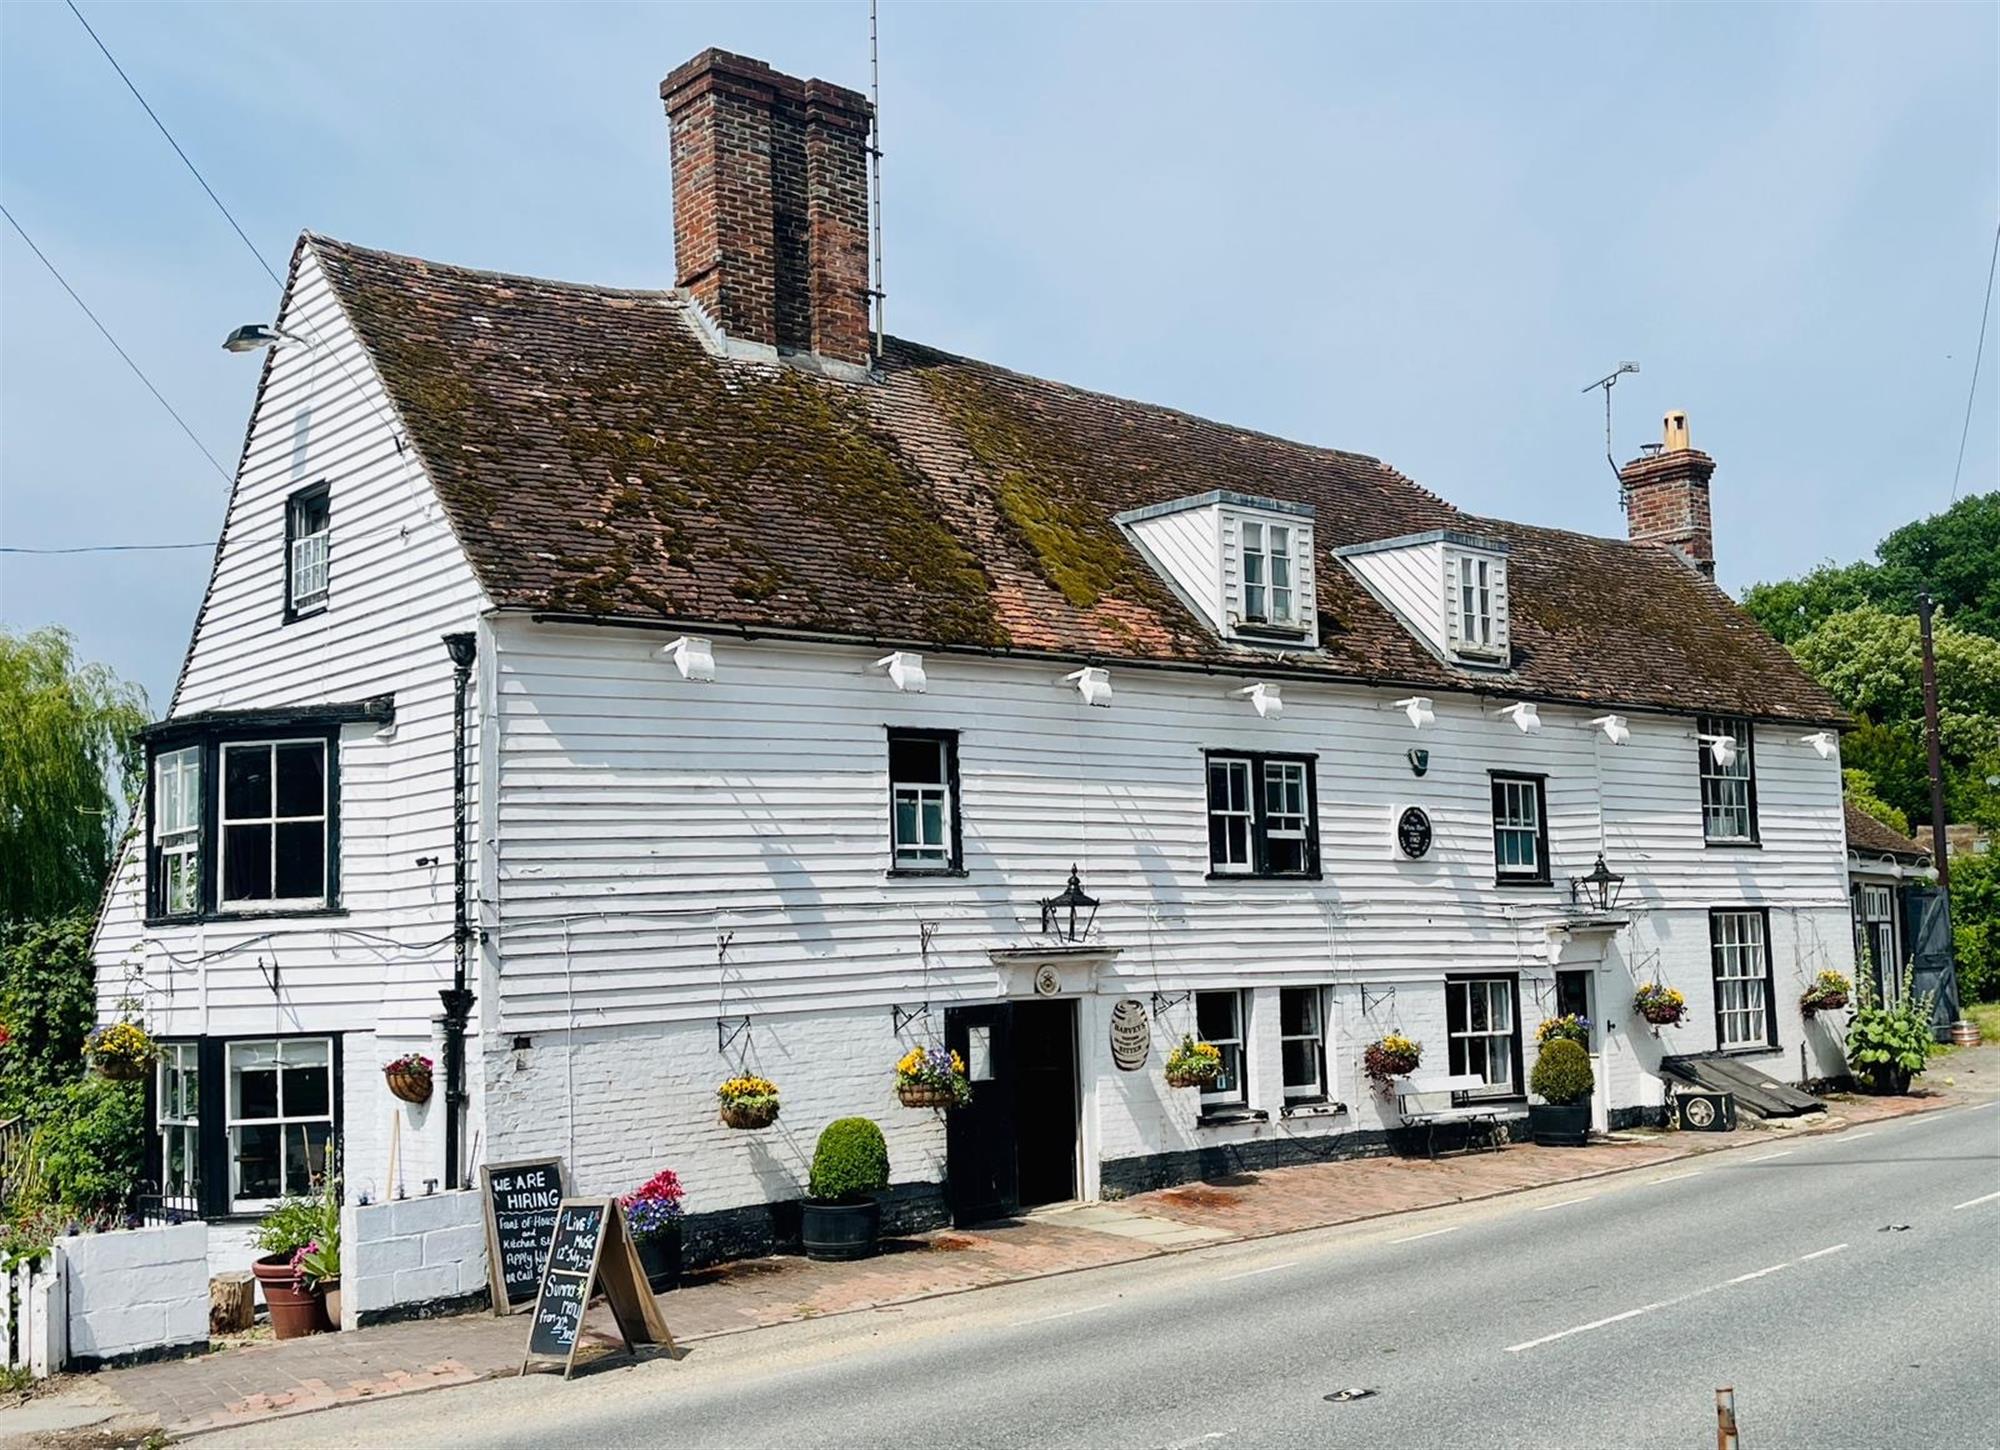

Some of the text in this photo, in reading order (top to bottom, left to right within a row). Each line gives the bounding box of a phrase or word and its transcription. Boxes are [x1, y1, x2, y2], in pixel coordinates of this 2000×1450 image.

[492, 1171, 546, 1192] WE ARE
[507, 1189, 560, 1209] HIRING
[534, 1215, 558, 1227] Hous
[522, 1228, 536, 1237] and
[517, 1270, 533, 1281] Call
